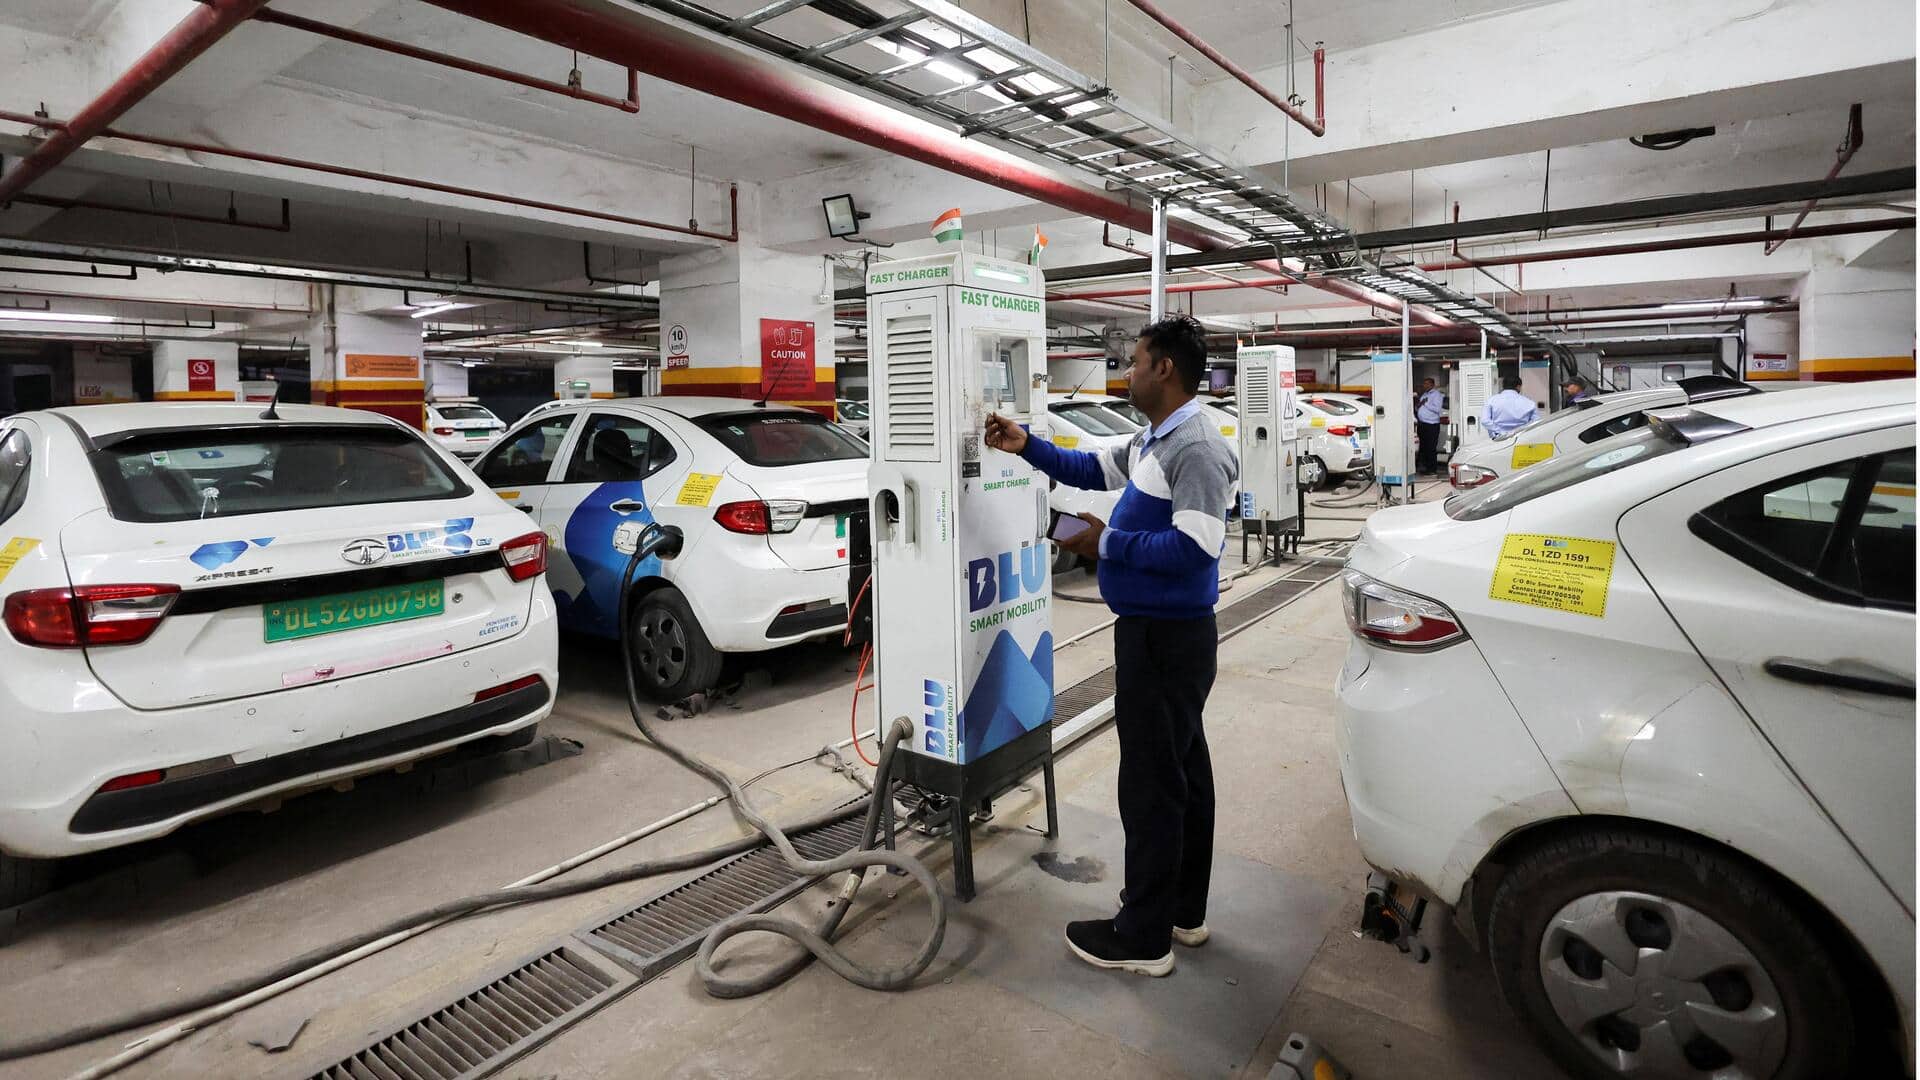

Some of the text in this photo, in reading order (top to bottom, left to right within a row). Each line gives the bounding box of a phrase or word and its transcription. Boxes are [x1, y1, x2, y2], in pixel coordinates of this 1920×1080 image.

[870, 266, 949, 284] FAST CHARGER
[961, 291, 1040, 313] FAST CHARGER
[672, 330, 683, 341] 10
[668, 357, 688, 367] SPEED
[771, 349, 806, 360] CAUTION
[1001, 468, 1014, 478] BLU
[984, 477, 1030, 491] SMART CHARGE
[1522, 548, 1590, 562] DL 1ZD 1591
[968, 543, 1047, 613] BLU
[285, 588, 441, 632] DL52GD0798
[969, 596, 1047, 633] SMART MOBILITY
[924, 679, 946, 756] BLU
